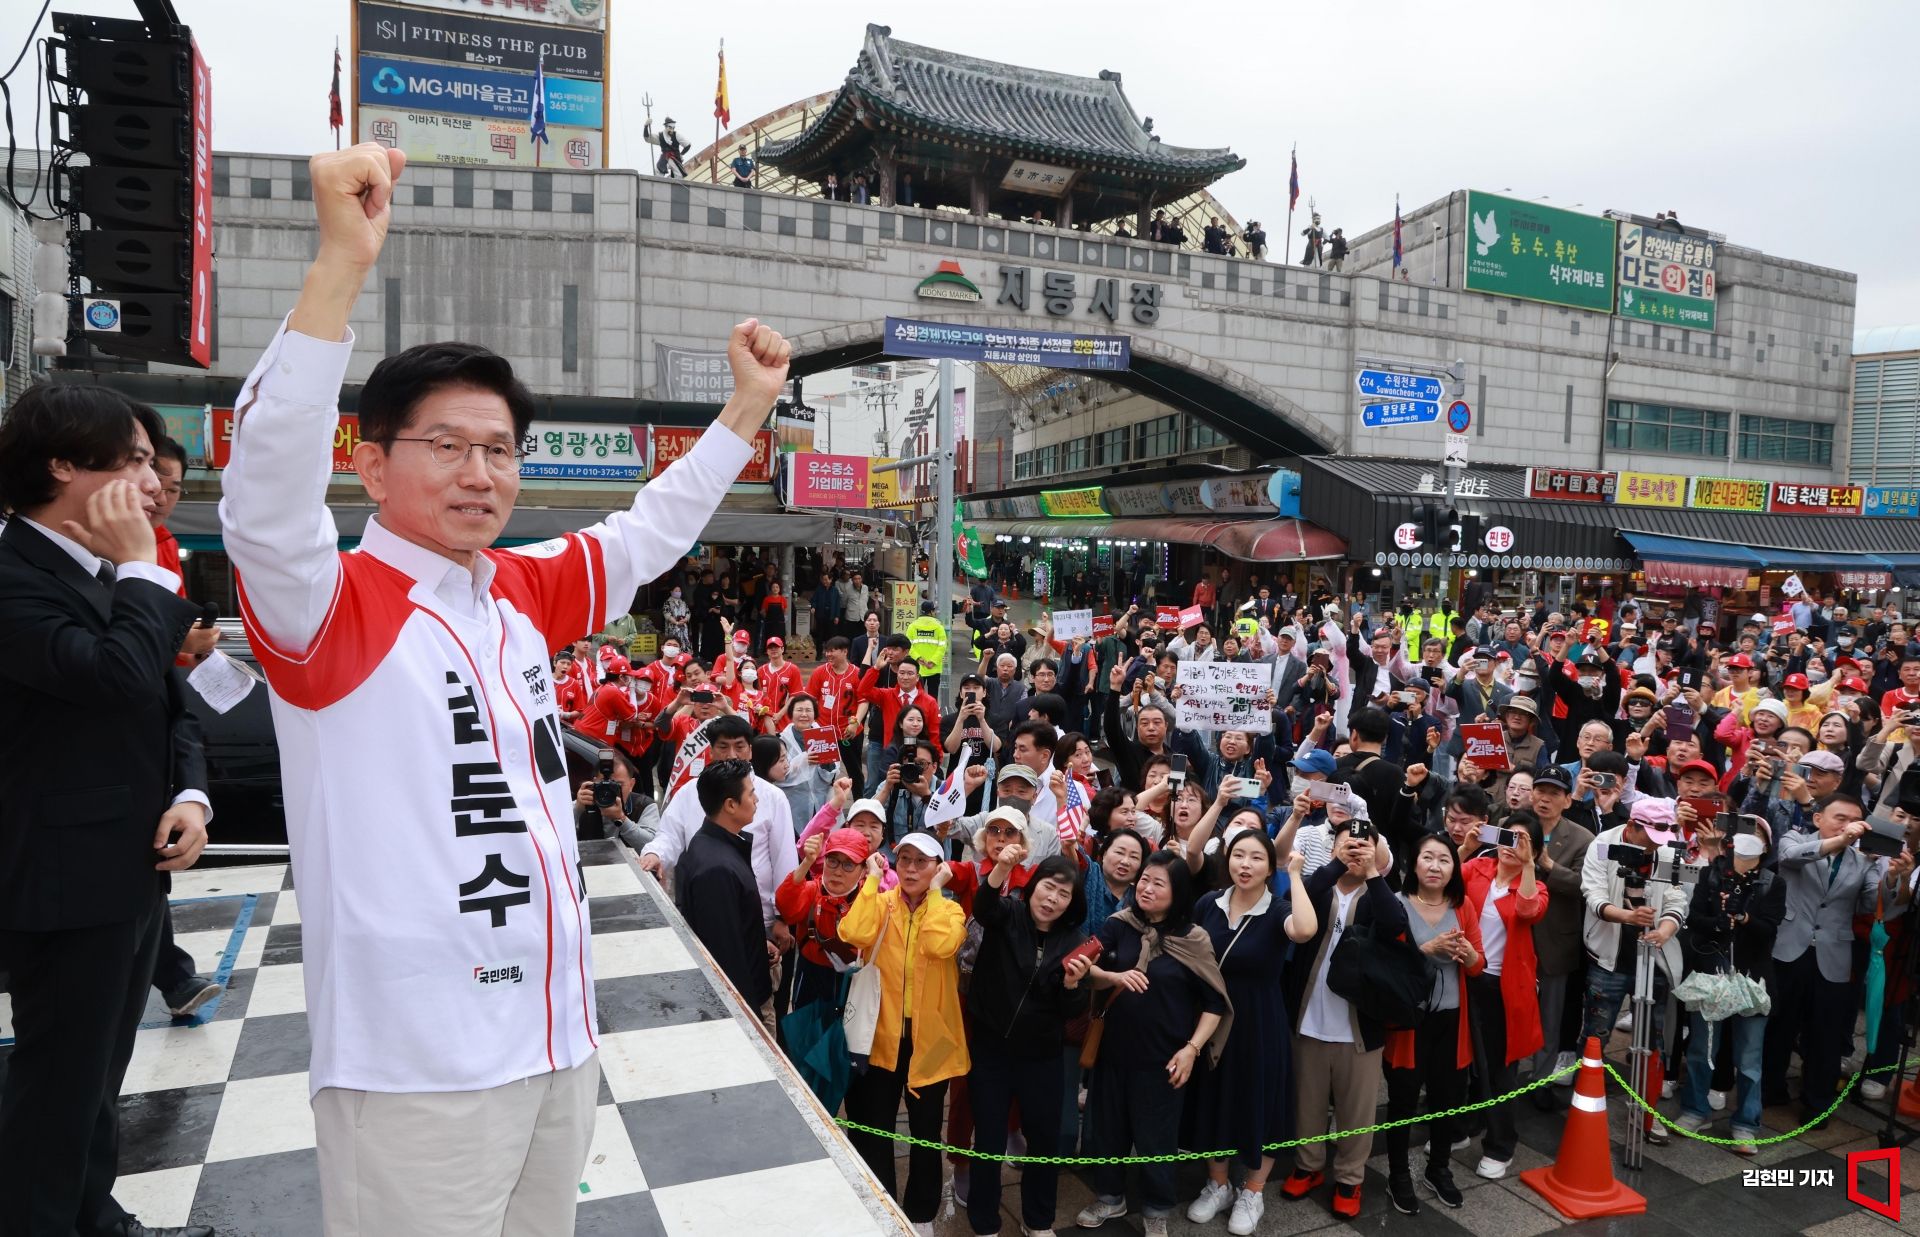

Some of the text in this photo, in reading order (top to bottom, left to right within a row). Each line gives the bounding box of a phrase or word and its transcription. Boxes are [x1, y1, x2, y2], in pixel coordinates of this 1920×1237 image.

[412, 26, 588, 59] FITNESS THE CLUB
[550, 101, 567, 111] 365
[408, 113, 472, 130] 이바지 떡전문
[491, 134, 516, 159] 떡
[568, 141, 590, 166] 떡
[1550, 264, 1604, 288] 식자재마트
[1623, 256, 1703, 297] 다도회집
[920, 288, 979, 300] JIDONG MARKET
[998, 266, 1163, 324] 지동시장
[984, 350, 1040, 363] 지동시장 상인회
[1361, 375, 1439, 394] 274 수원천로 270
[1366, 412, 1374, 420] 18
[1383, 403, 1416, 416] 팔달문로
[544, 431, 634, 456] 영광상회
[809, 461, 854, 476] 우수중소
[808, 476, 855, 491] 기업매장
[1552, 474, 1614, 495] 中国食品
[1777, 486, 1798, 505] 지동
[1799, 487, 1828, 506] 축산물
[1489, 531, 1511, 548] 찐빵
[896, 584, 916, 594] TV
[896, 598, 917, 607] 홈쇼핑
[896, 610, 915, 619] 중소
[1183, 666, 1206, 680] 지금의
[479, 965, 520, 984] 국민의힘
